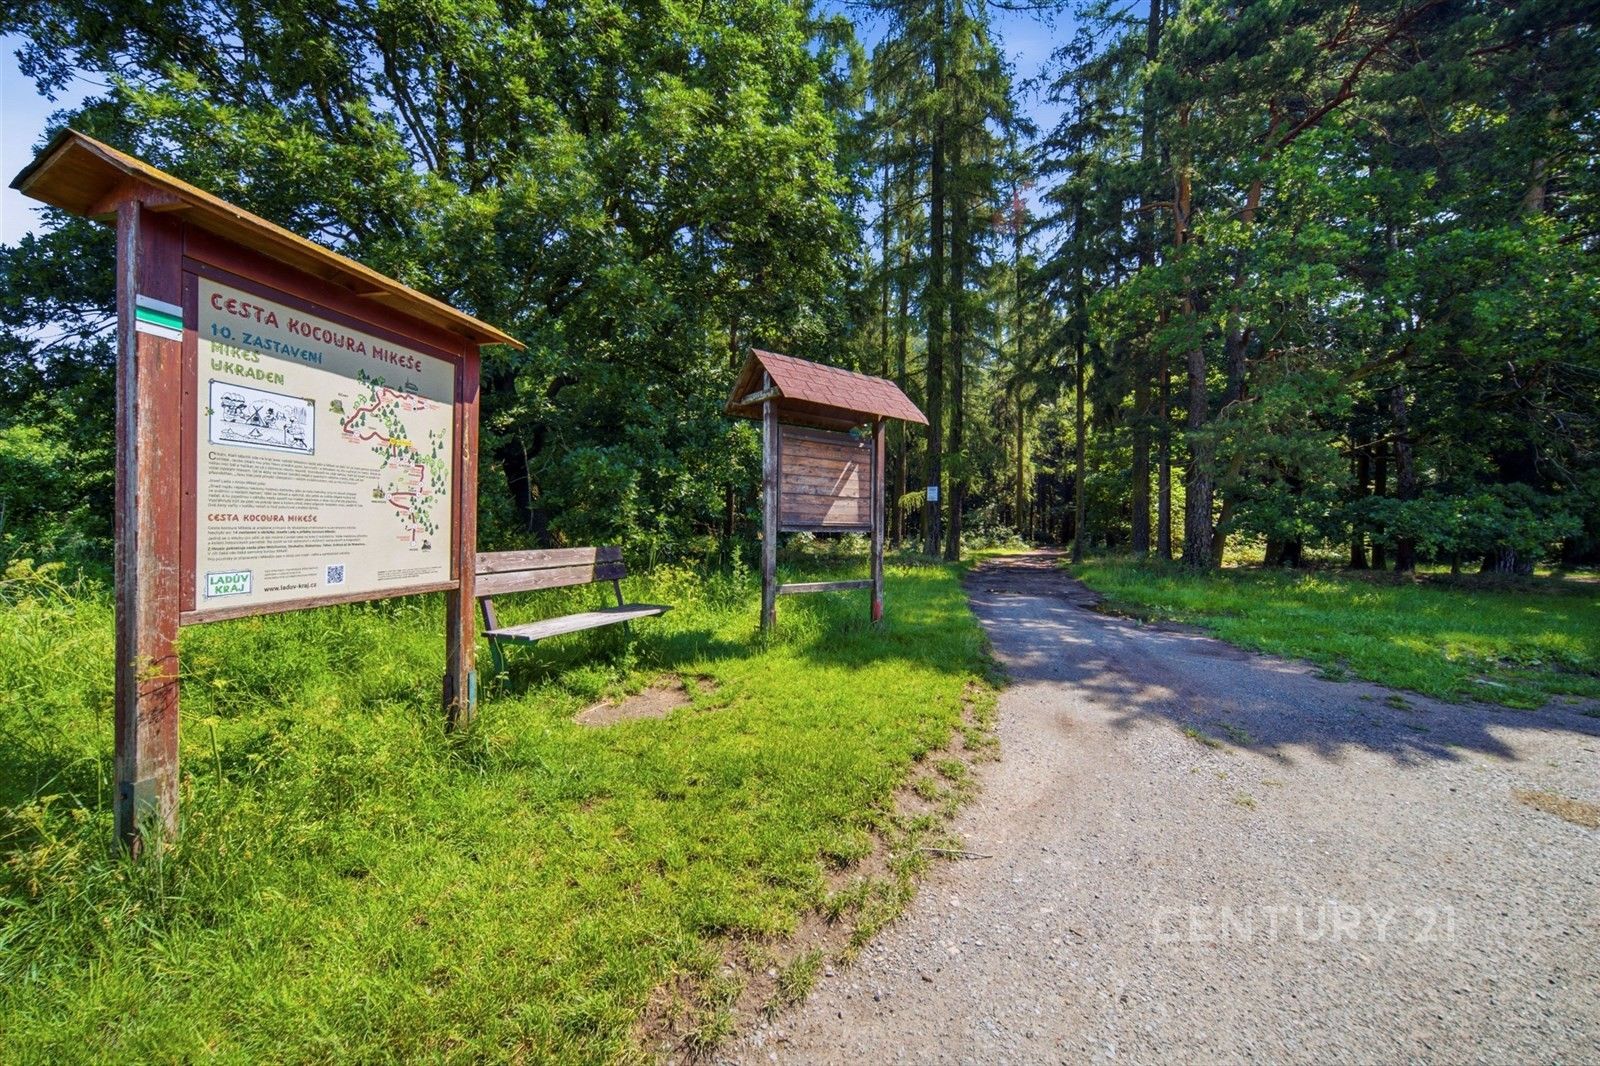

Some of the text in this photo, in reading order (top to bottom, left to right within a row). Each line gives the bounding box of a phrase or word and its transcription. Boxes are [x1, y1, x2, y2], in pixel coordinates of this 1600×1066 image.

[210, 292, 422, 373] CESTA KOCOURA MIKEŠE
[210, 323, 323, 365] 10. ZASTAVENÍ
[210, 341, 261, 363] MIKEŠ
[210, 358, 285, 386] UKRADEN
[207, 513, 318, 523] CESTA KOCOURA MIKEŠE
[210, 573, 249, 586] LADŮV
[214, 584, 246, 595] KRAJ
